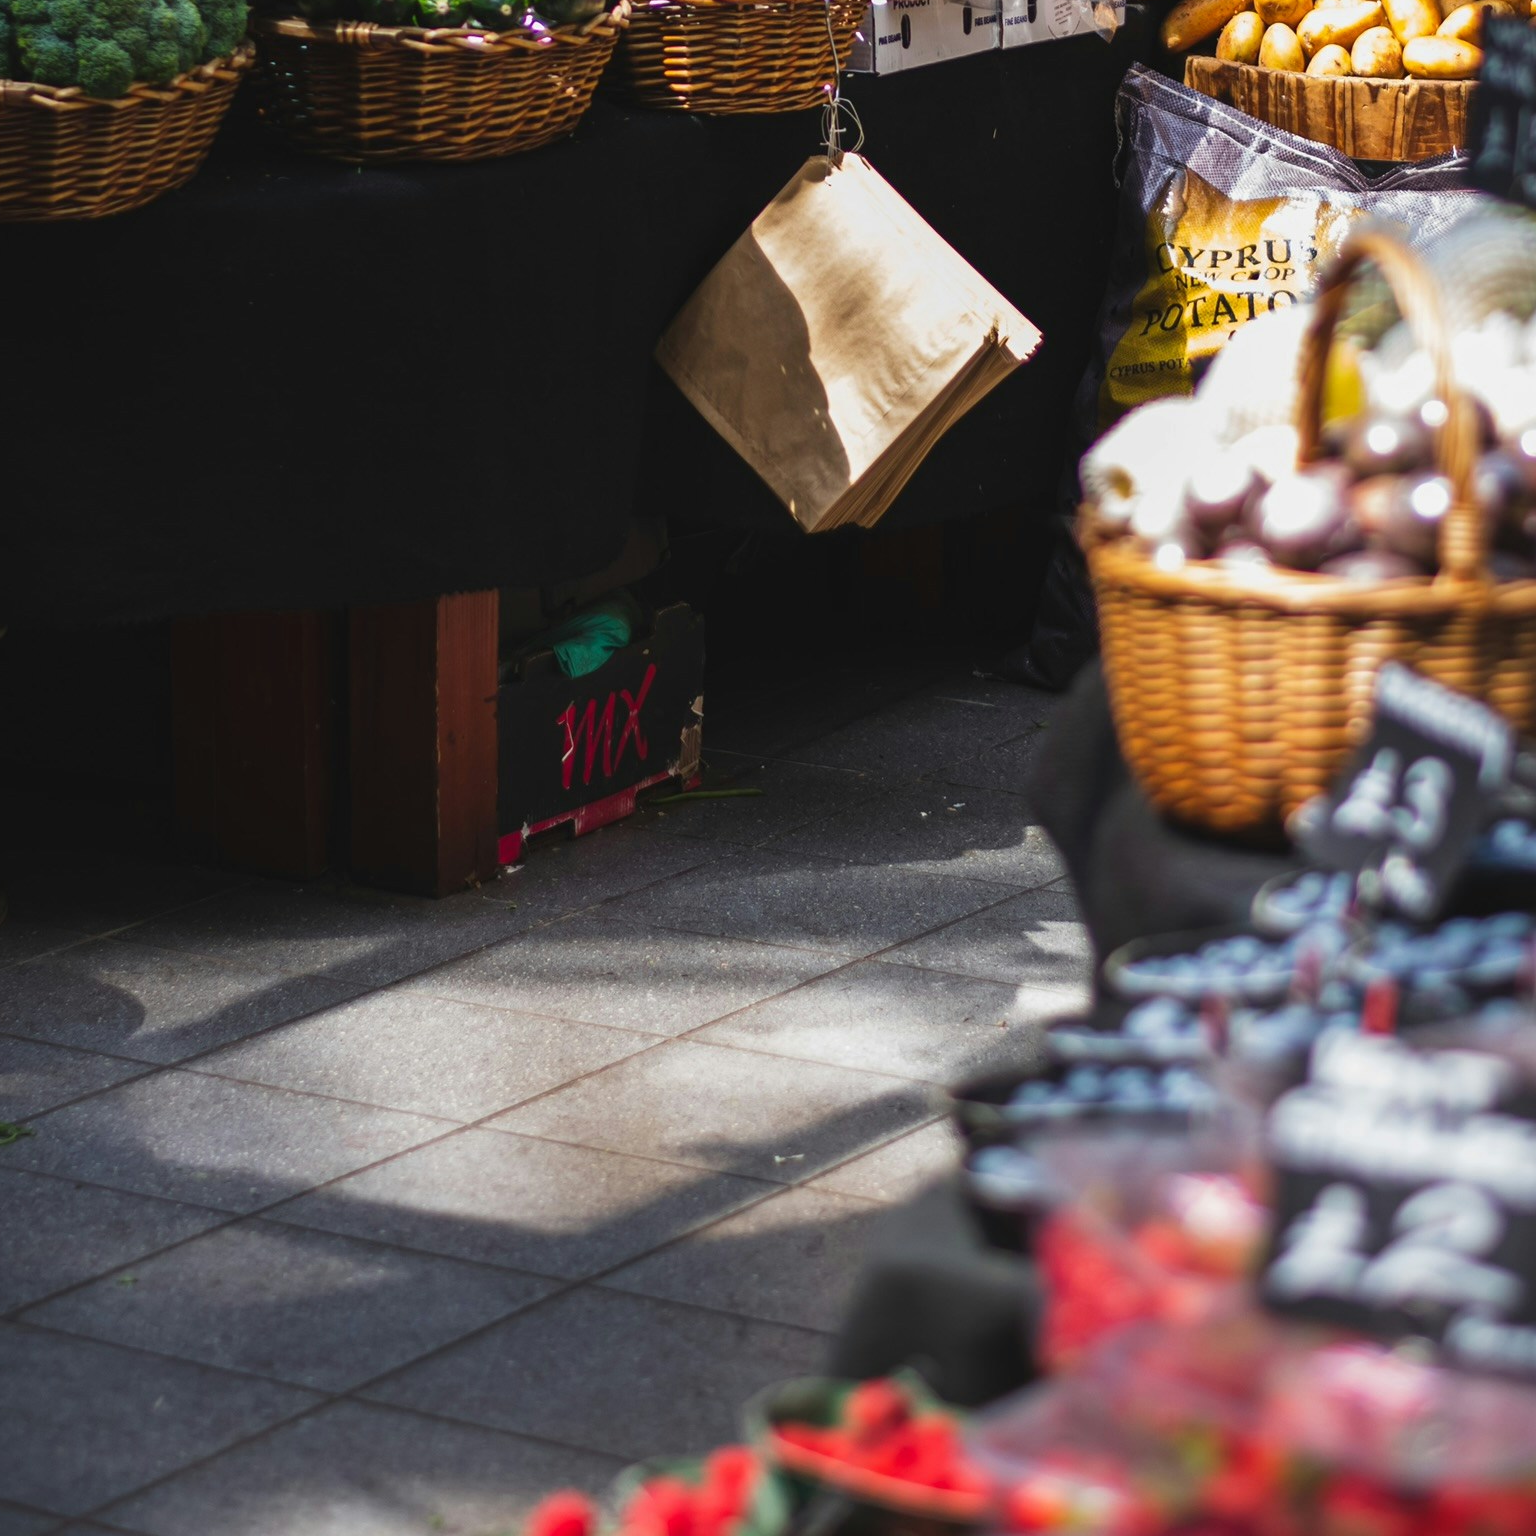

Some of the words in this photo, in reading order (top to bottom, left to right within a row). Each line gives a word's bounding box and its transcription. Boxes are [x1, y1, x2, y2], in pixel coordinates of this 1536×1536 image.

[1230, 266, 1296, 283] COP
[1139, 289, 1300, 337] POTATO
[1109, 361, 1156, 379] CYPRUS
[1159, 357, 1194, 373] POTA
